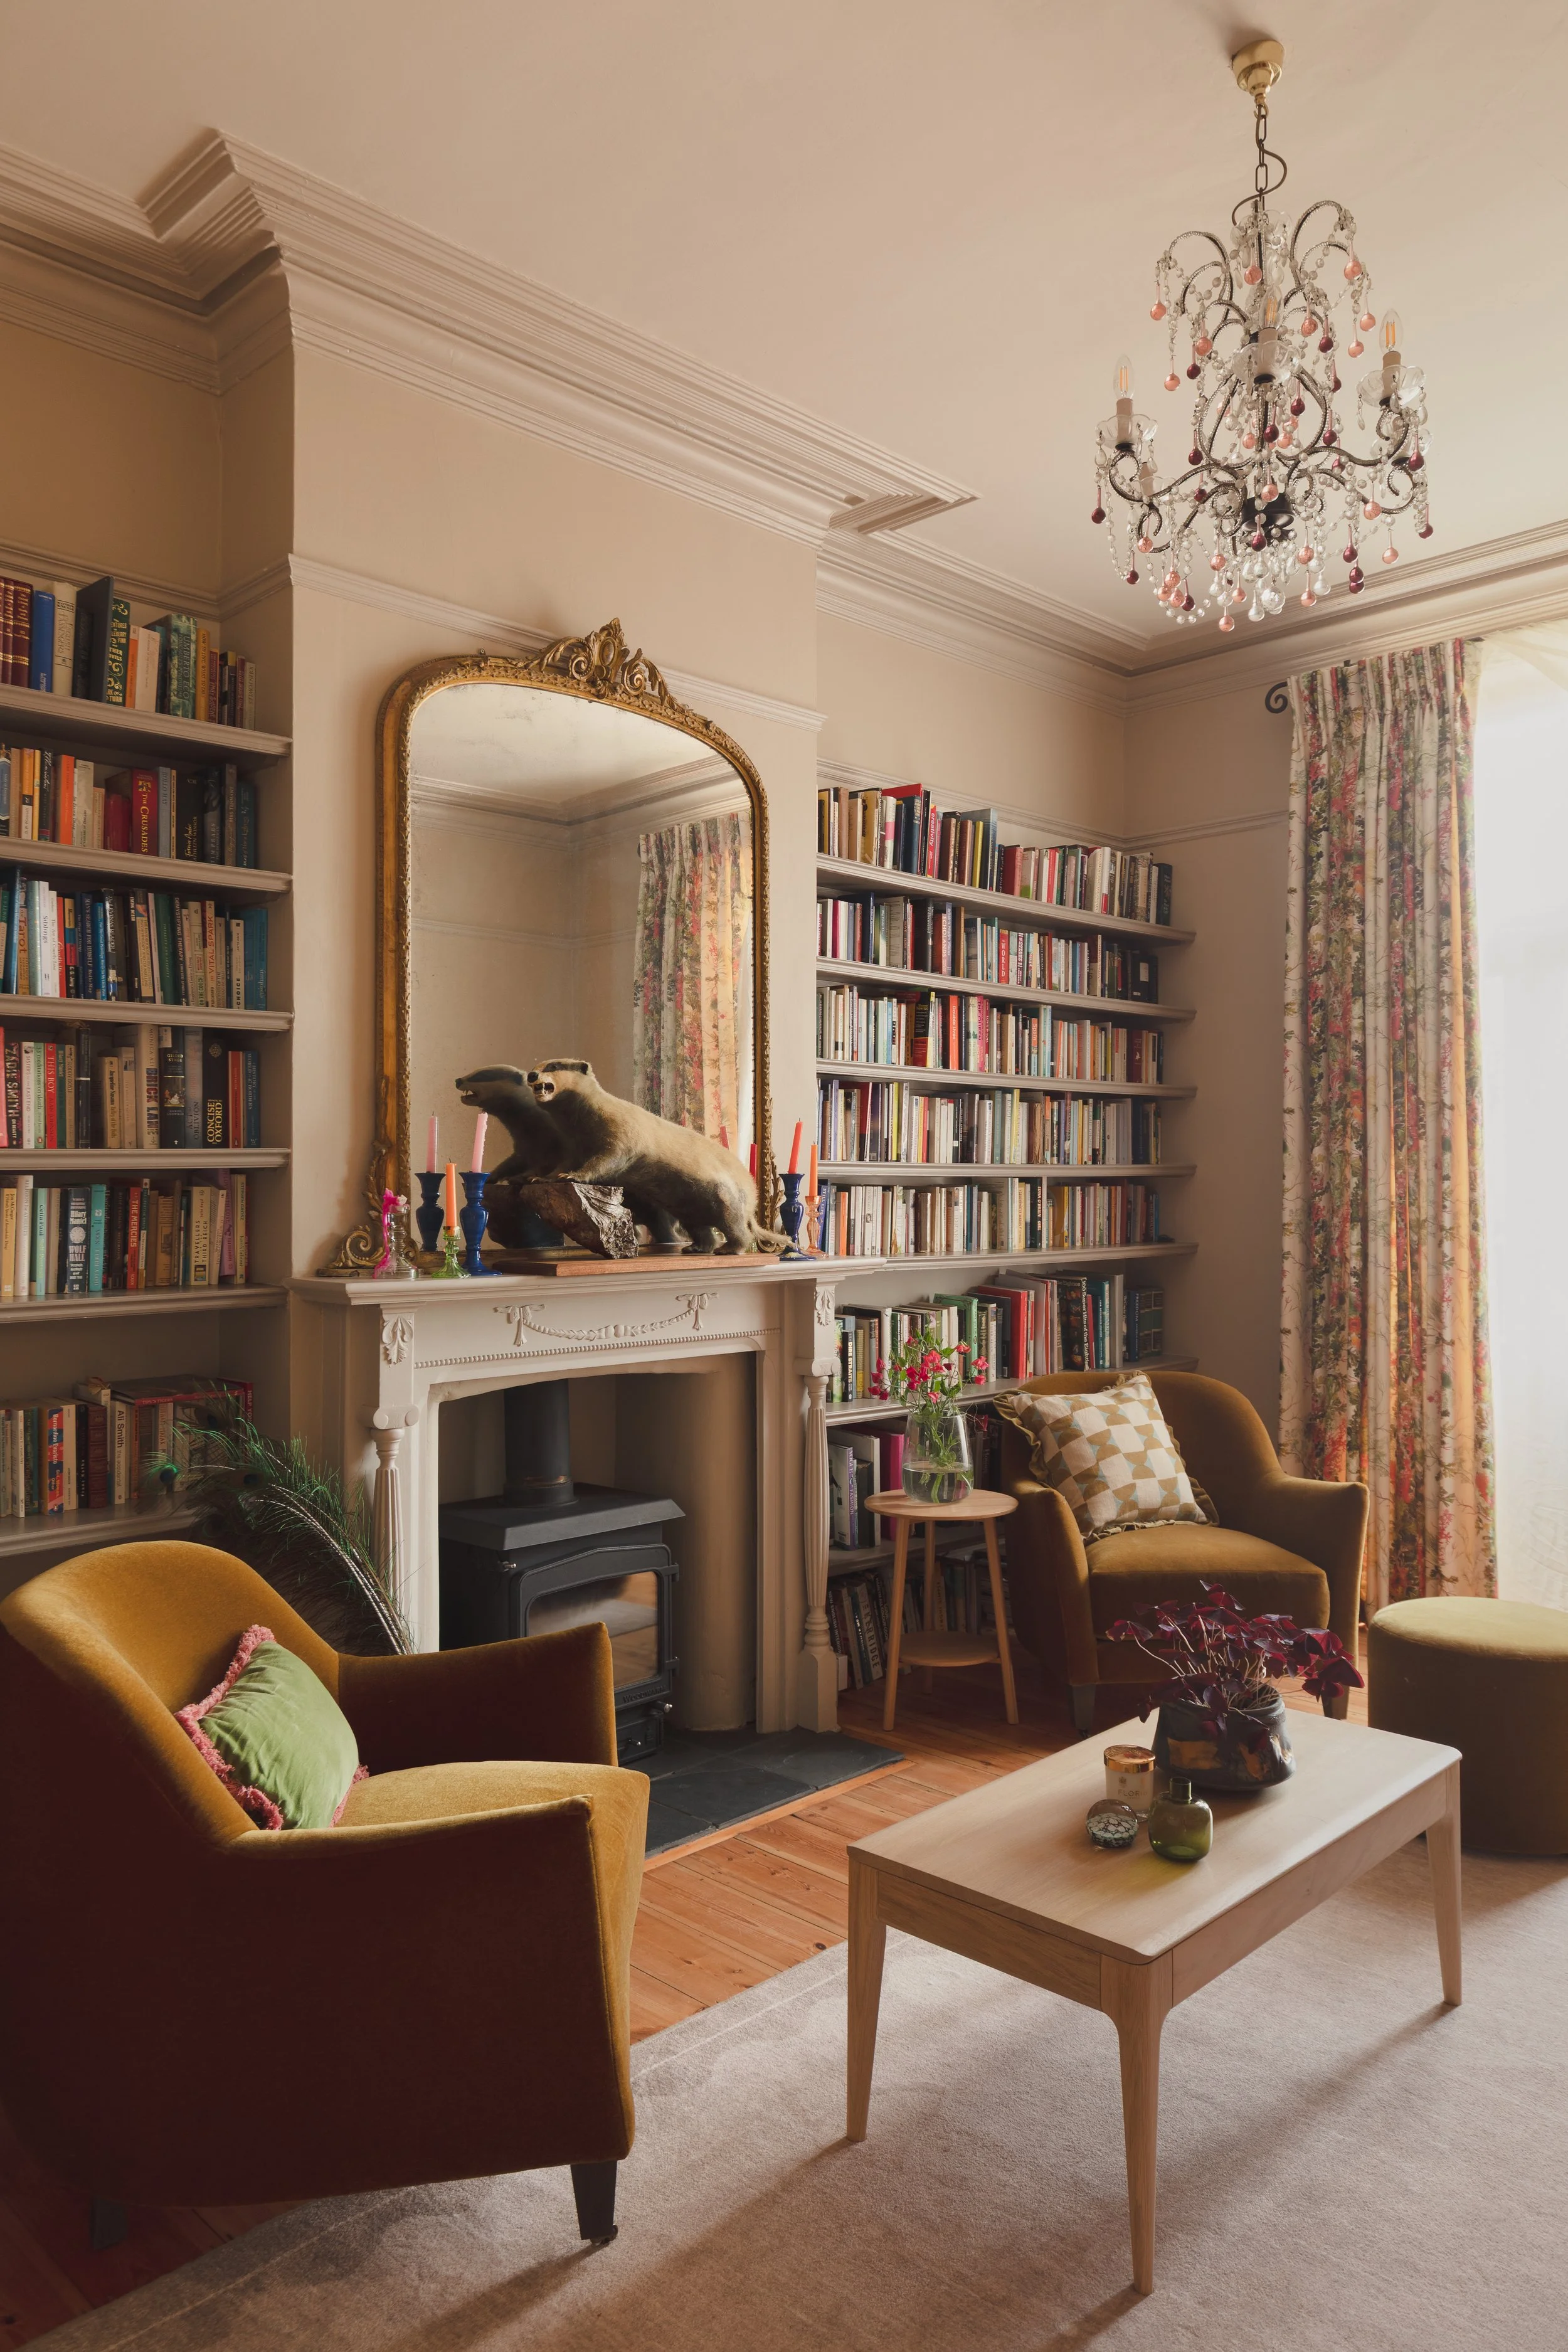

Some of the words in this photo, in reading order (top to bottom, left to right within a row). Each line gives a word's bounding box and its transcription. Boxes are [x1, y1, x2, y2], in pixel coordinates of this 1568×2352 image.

[183, 635, 191, 678] UMBERTO
[183, 681, 191, 699] ECO
[140, 805, 150, 853] CRUSADES
[183, 823, 193, 840] Amber
[174, 898, 183, 936] DEMYSTIFYING
[18, 917, 28, 954] Tarot
[257, 968, 266, 999] epiphany
[5, 1048, 18, 1079] ZADIE
[7, 1081, 21, 1118] SMITH
[47, 1077, 55, 1093] BOY
[146, 1068, 158, 1103] BRICK
[147, 1106, 159, 1135] LANE
[207, 1102, 215, 1143] CONCISE
[70, 1210, 87, 1219] Hilary
[130, 1216, 138, 1248] MERCIES
[69, 1245, 87, 1253] WOLF
[69, 1253, 85, 1261] HALL
[117, 1410, 125, 1421] Ali
[116, 1423, 125, 1448] Smith
[830, 1605, 838, 1628] ENGLISH
